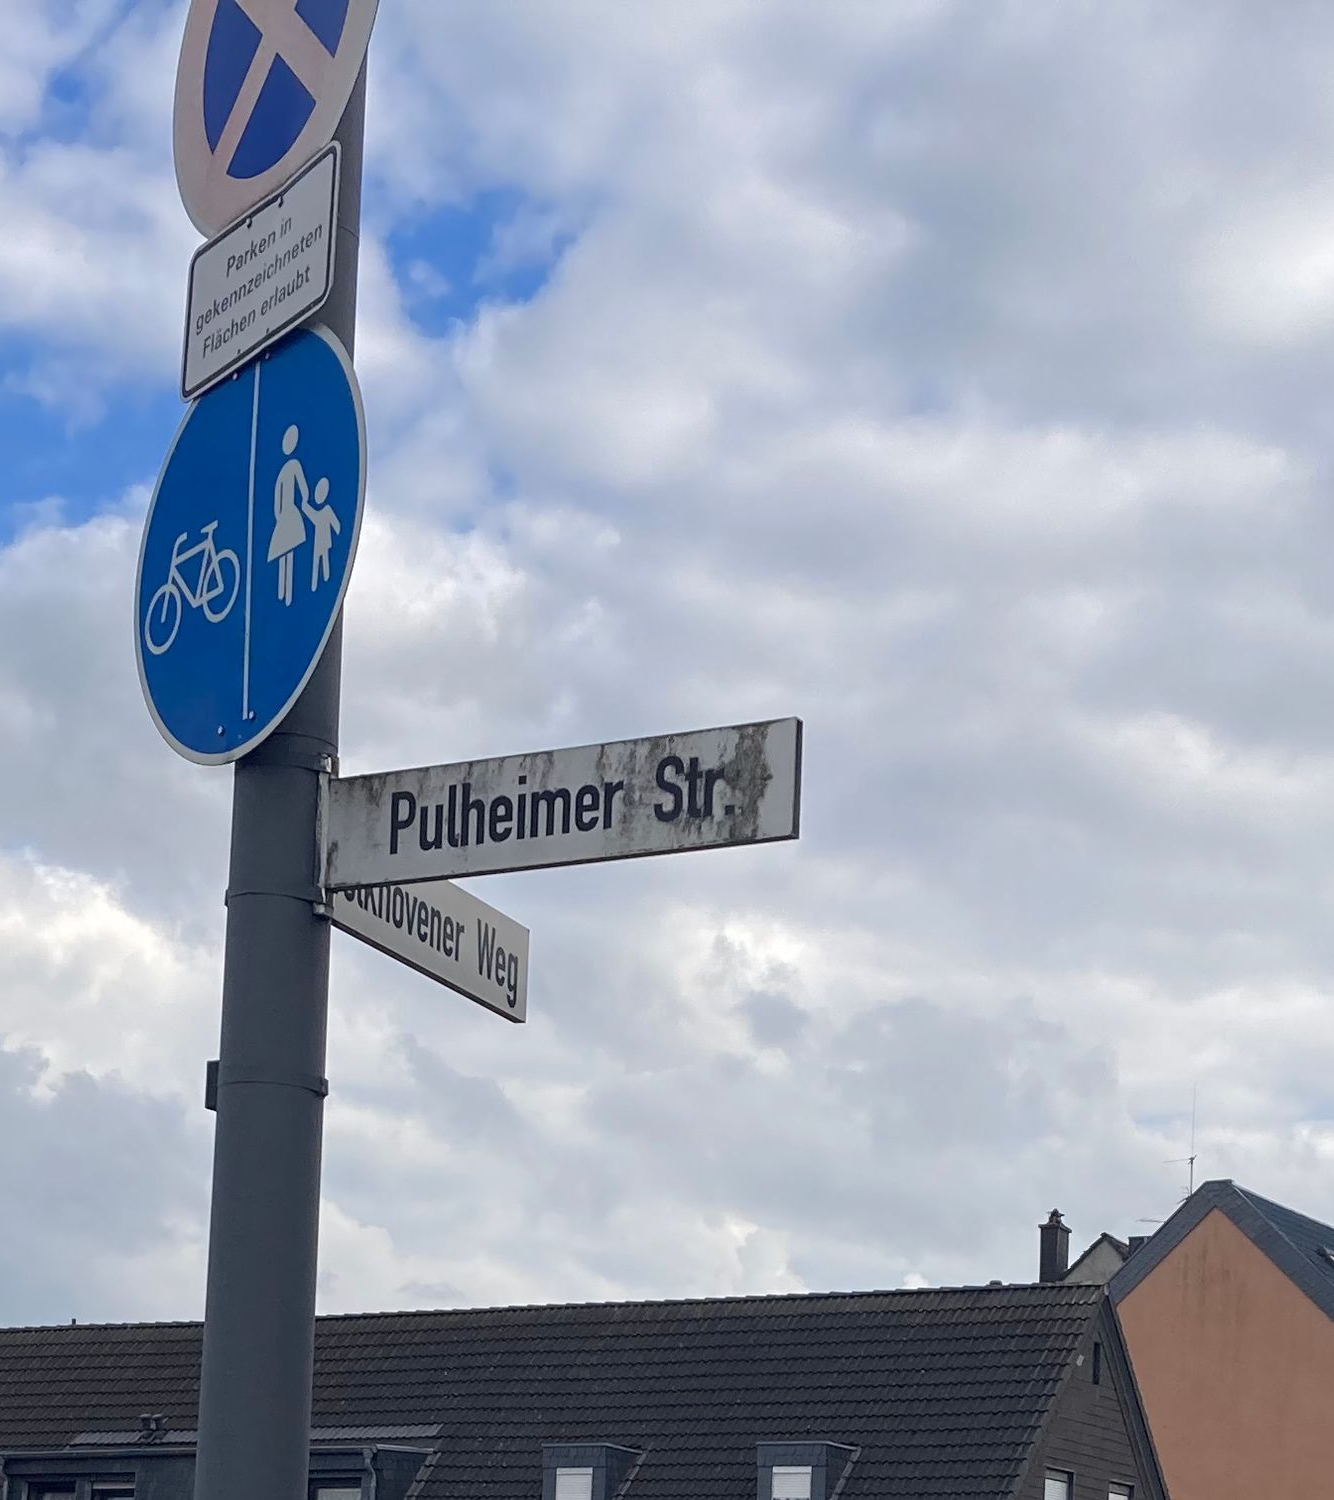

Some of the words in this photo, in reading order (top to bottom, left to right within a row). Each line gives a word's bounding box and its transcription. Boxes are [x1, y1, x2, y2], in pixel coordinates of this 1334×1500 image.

[195, 223, 323, 336] gekennzeichneten
[226, 230, 276, 278] Parken
[280, 216, 292, 239] in
[202, 308, 256, 359] Flächen
[260, 264, 310, 316] erlaubt
[389, 775, 624, 855] Pulheimer
[653, 755, 736, 823] Str.
[477, 917, 519, 1009] Weg
